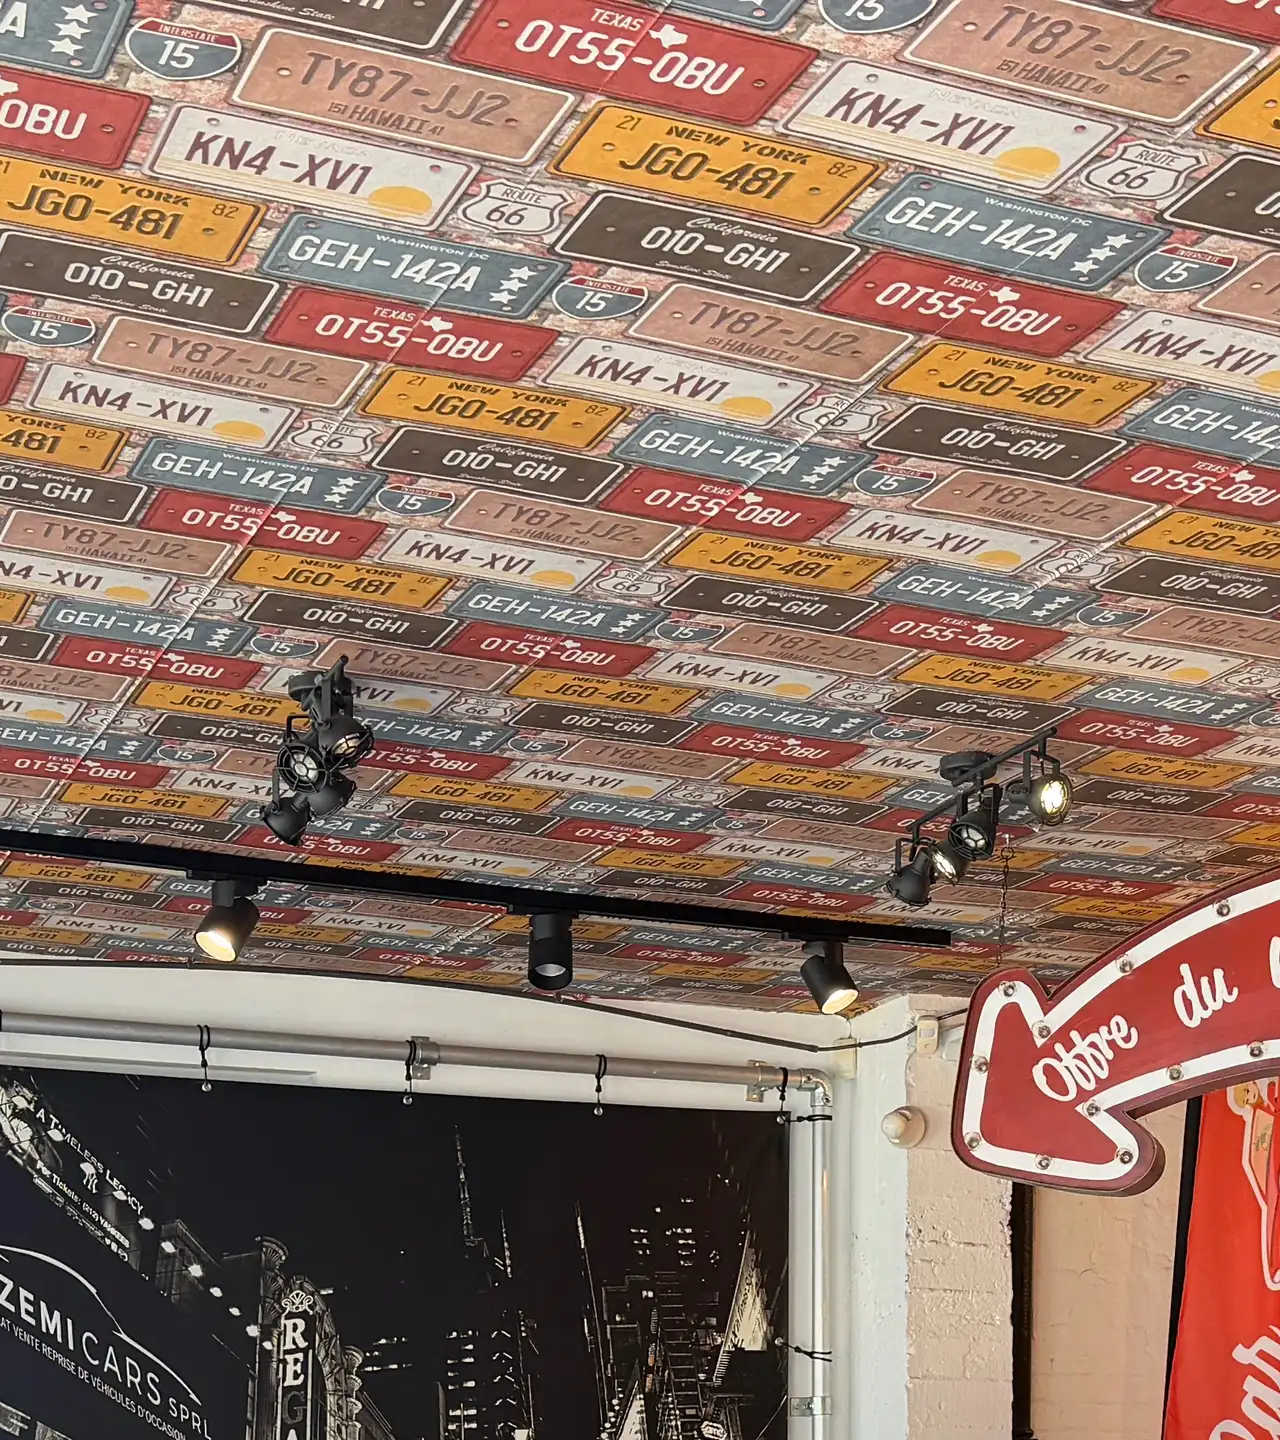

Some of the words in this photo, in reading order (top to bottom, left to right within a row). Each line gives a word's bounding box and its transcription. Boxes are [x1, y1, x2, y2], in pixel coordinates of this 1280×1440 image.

[591, 8, 642, 30] TEXAS
[159, 40, 198, 69] 15
[665, 126, 729, 145] NEW
[742, 142, 811, 164] YORK
[1128, 150, 1180, 168] ROUTE
[39, 169, 103, 187] NEW
[120, 184, 190, 205] YORK
[1107, 167, 1155, 189] 66
[496, 189, 546, 205] ROUTE
[485, 204, 527, 225] 66
[686, 218, 777, 242] California
[884, 199, 1076, 258] GEH-142A
[288, 235, 480, 291] GEH-142A
[1155, 262, 1198, 282] 15
[944, 275, 986, 290] TEXAS
[576, 291, 613, 311] 15
[374, 307, 415, 321] TEXAS
[447, 382, 500, 395] NEW
[512, 391, 569, 406] YORK
[1031, 1014, 1139, 1103] Offre
[1173, 962, 1239, 1029] du
[12, 1325, 42, 1352] VENTE
[41, 1342, 77, 1376] REPRISE
[77, 1366, 91, 1385] DE
[168, 1396, 213, 1440] SPRL
